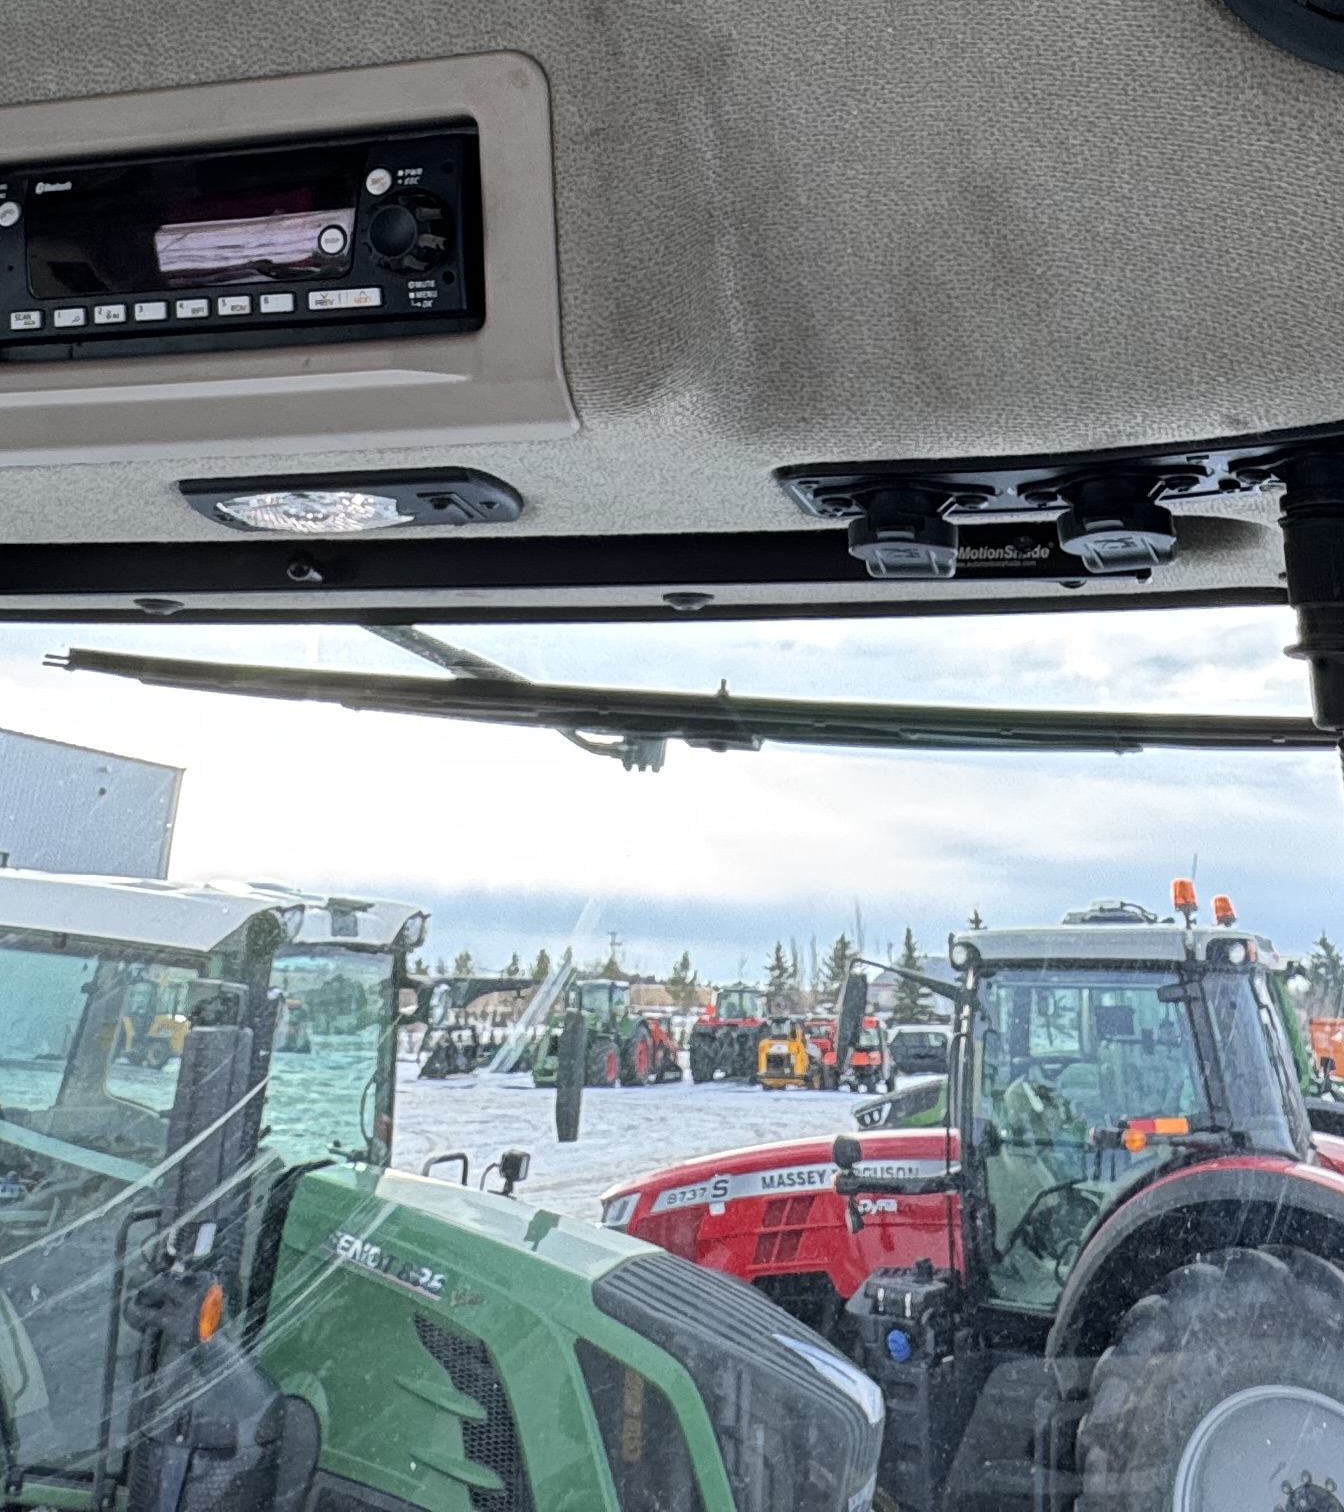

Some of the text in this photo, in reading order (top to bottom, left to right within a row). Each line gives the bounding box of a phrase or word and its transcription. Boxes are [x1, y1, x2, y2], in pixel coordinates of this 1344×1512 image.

[666, 1178, 730, 1205] 8737 S
[761, 1168, 826, 1191] MASSEY
